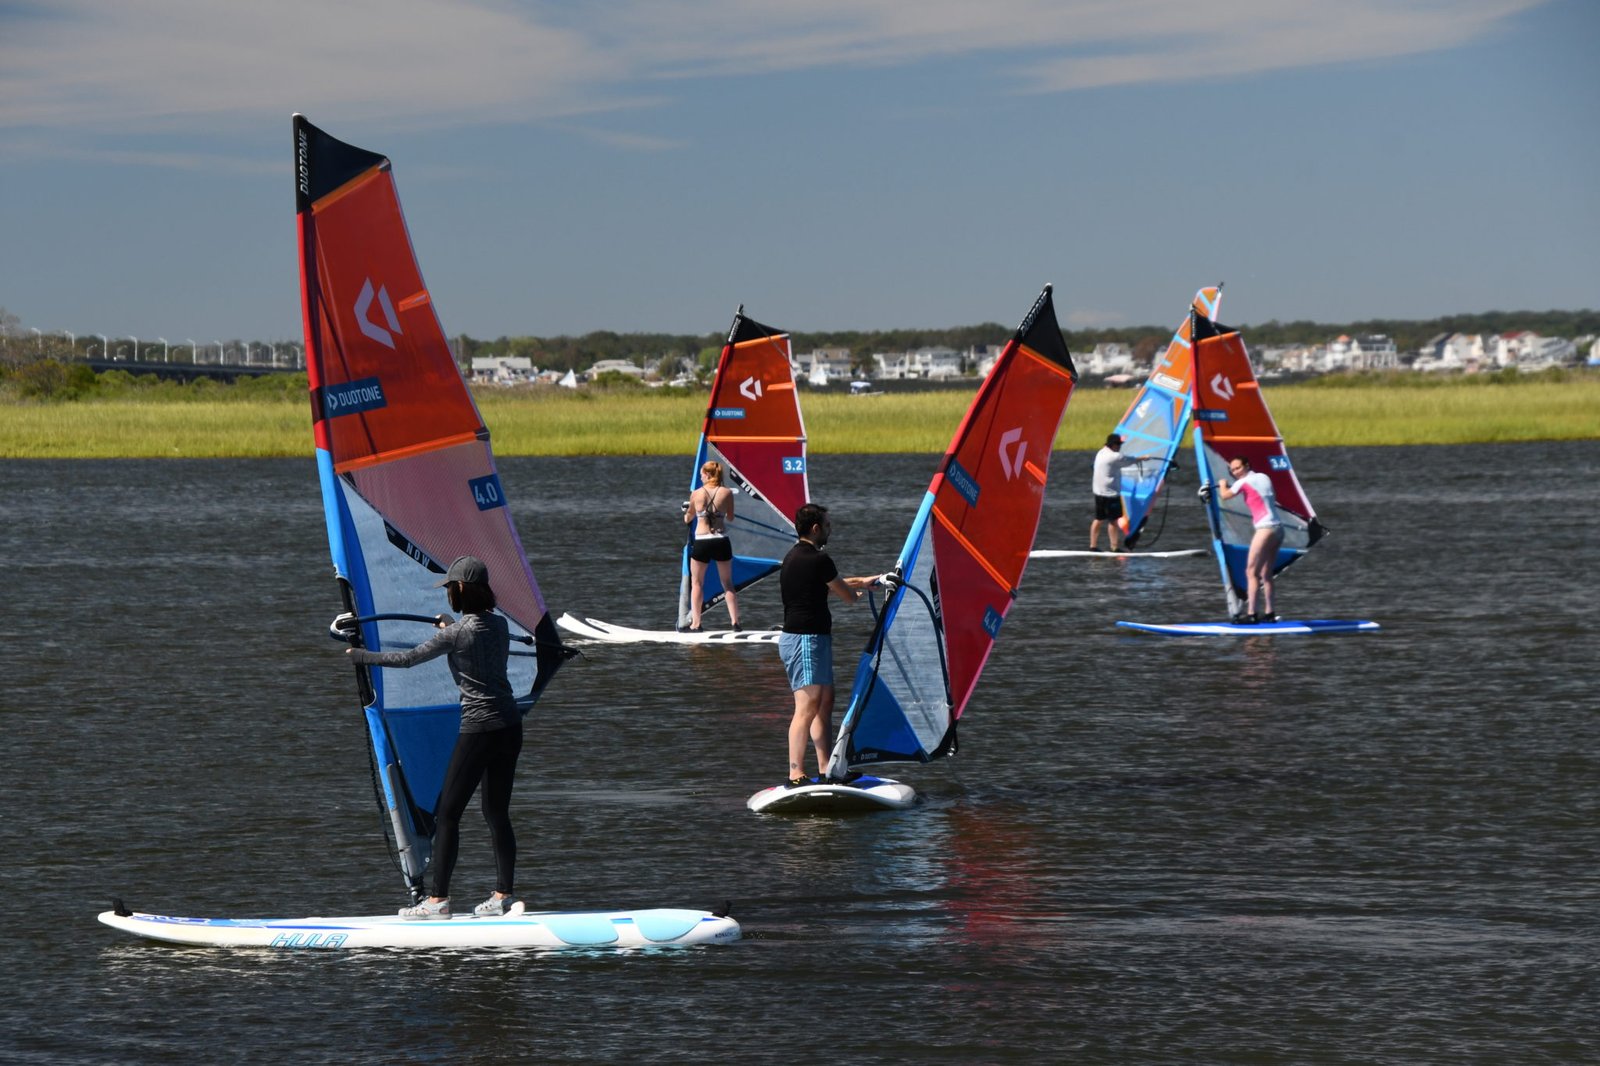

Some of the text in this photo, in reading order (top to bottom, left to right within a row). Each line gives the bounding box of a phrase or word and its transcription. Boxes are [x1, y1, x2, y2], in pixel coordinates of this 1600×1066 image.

[299, 129, 309, 195] DUOTONE
[338, 385, 382, 407] DUOTONE
[784, 460, 803, 471] 3.2
[1270, 458, 1288, 469] 3.6
[474, 482, 498, 505] 4.0
[740, 481, 757, 497] NOW
[954, 470, 979, 501] DUOTONE
[405, 542, 431, 568] NOW
[984, 610, 997, 633] 4.4
[270, 932, 349, 949] HULA
